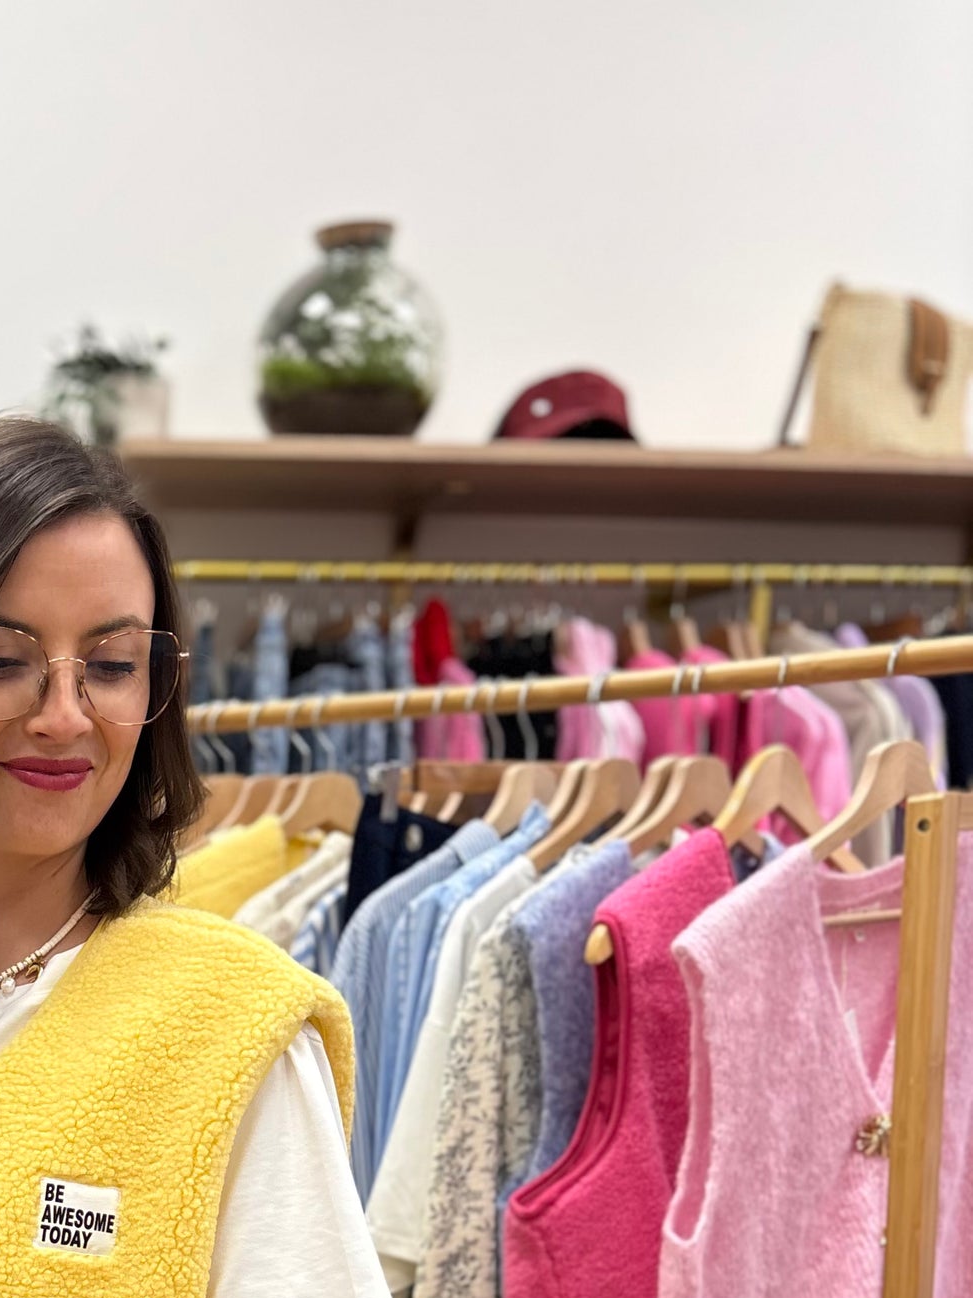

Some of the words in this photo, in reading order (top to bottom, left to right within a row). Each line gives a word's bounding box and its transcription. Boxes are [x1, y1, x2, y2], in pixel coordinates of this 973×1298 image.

[45, 1183, 65, 1203] BE
[41, 1204, 115, 1233] AWESOME
[40, 1224, 92, 1249] TODAY
